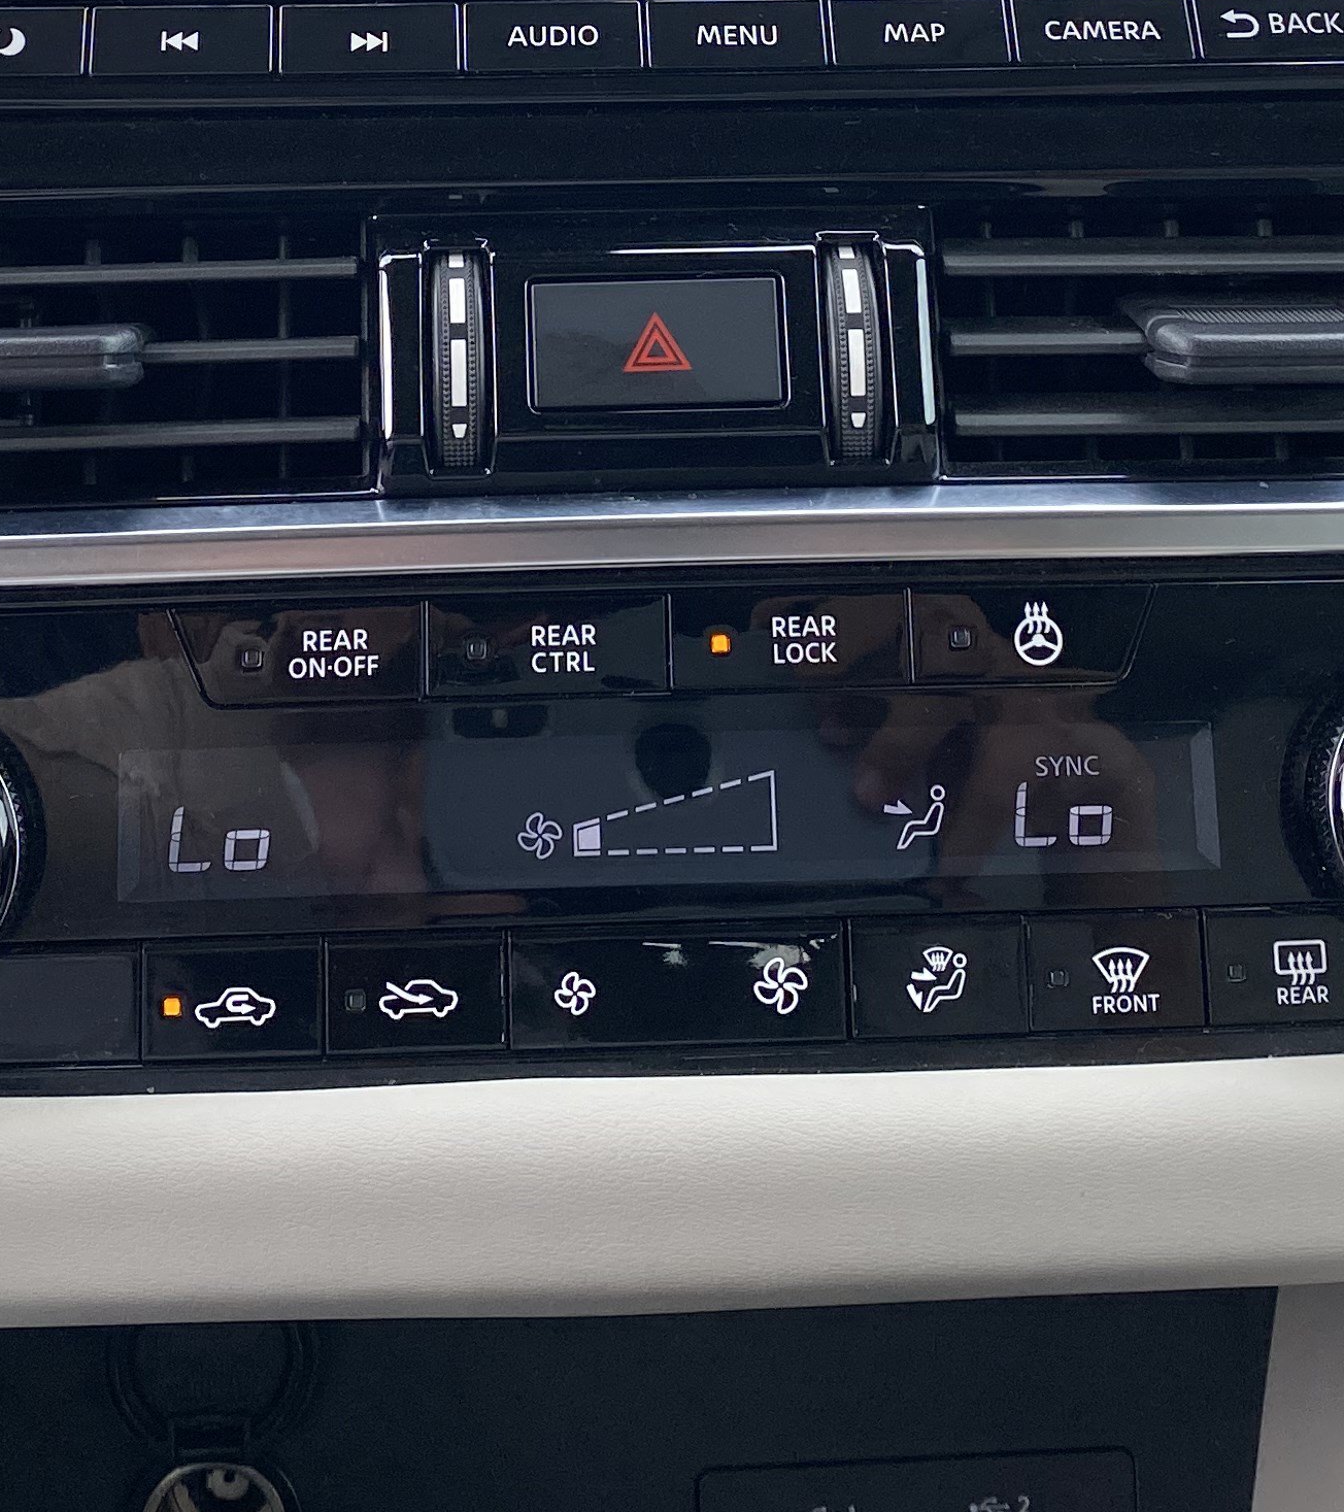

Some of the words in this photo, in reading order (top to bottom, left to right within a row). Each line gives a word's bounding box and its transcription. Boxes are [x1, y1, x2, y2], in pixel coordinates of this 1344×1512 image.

[696, 23, 779, 47] MENU
[883, 21, 947, 45] MAP
[1043, 18, 1162, 42] CAMERA
[1268, 11, 1344, 36] BACK
[506, 24, 600, 48] AUDIO
[530, 623, 597, 648] REAR
[771, 614, 837, 639] REAR
[302, 627, 369, 653] REAR
[530, 650, 596, 674] CTRL
[772, 641, 838, 665] LOCK
[1034, 754, 1101, 778] SYNC
[1091, 992, 1161, 1016] FRONT
[1276, 984, 1330, 1006] REAR
